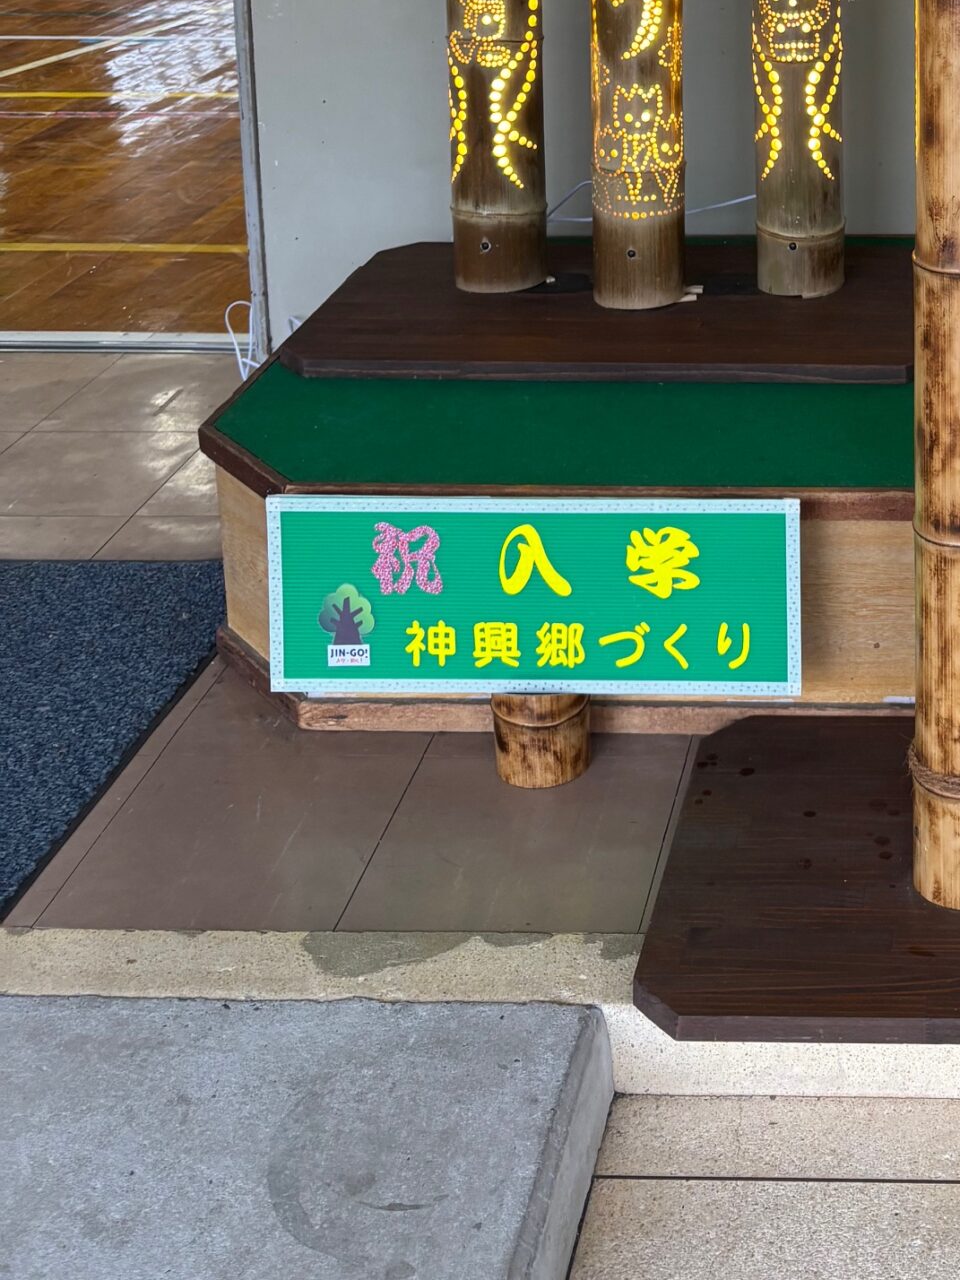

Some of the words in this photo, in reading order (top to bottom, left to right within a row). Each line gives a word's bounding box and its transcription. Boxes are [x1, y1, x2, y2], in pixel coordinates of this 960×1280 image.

[330, 648, 369, 659] JIN-GO!
[404, 619, 751, 670] 神興郷づくり
